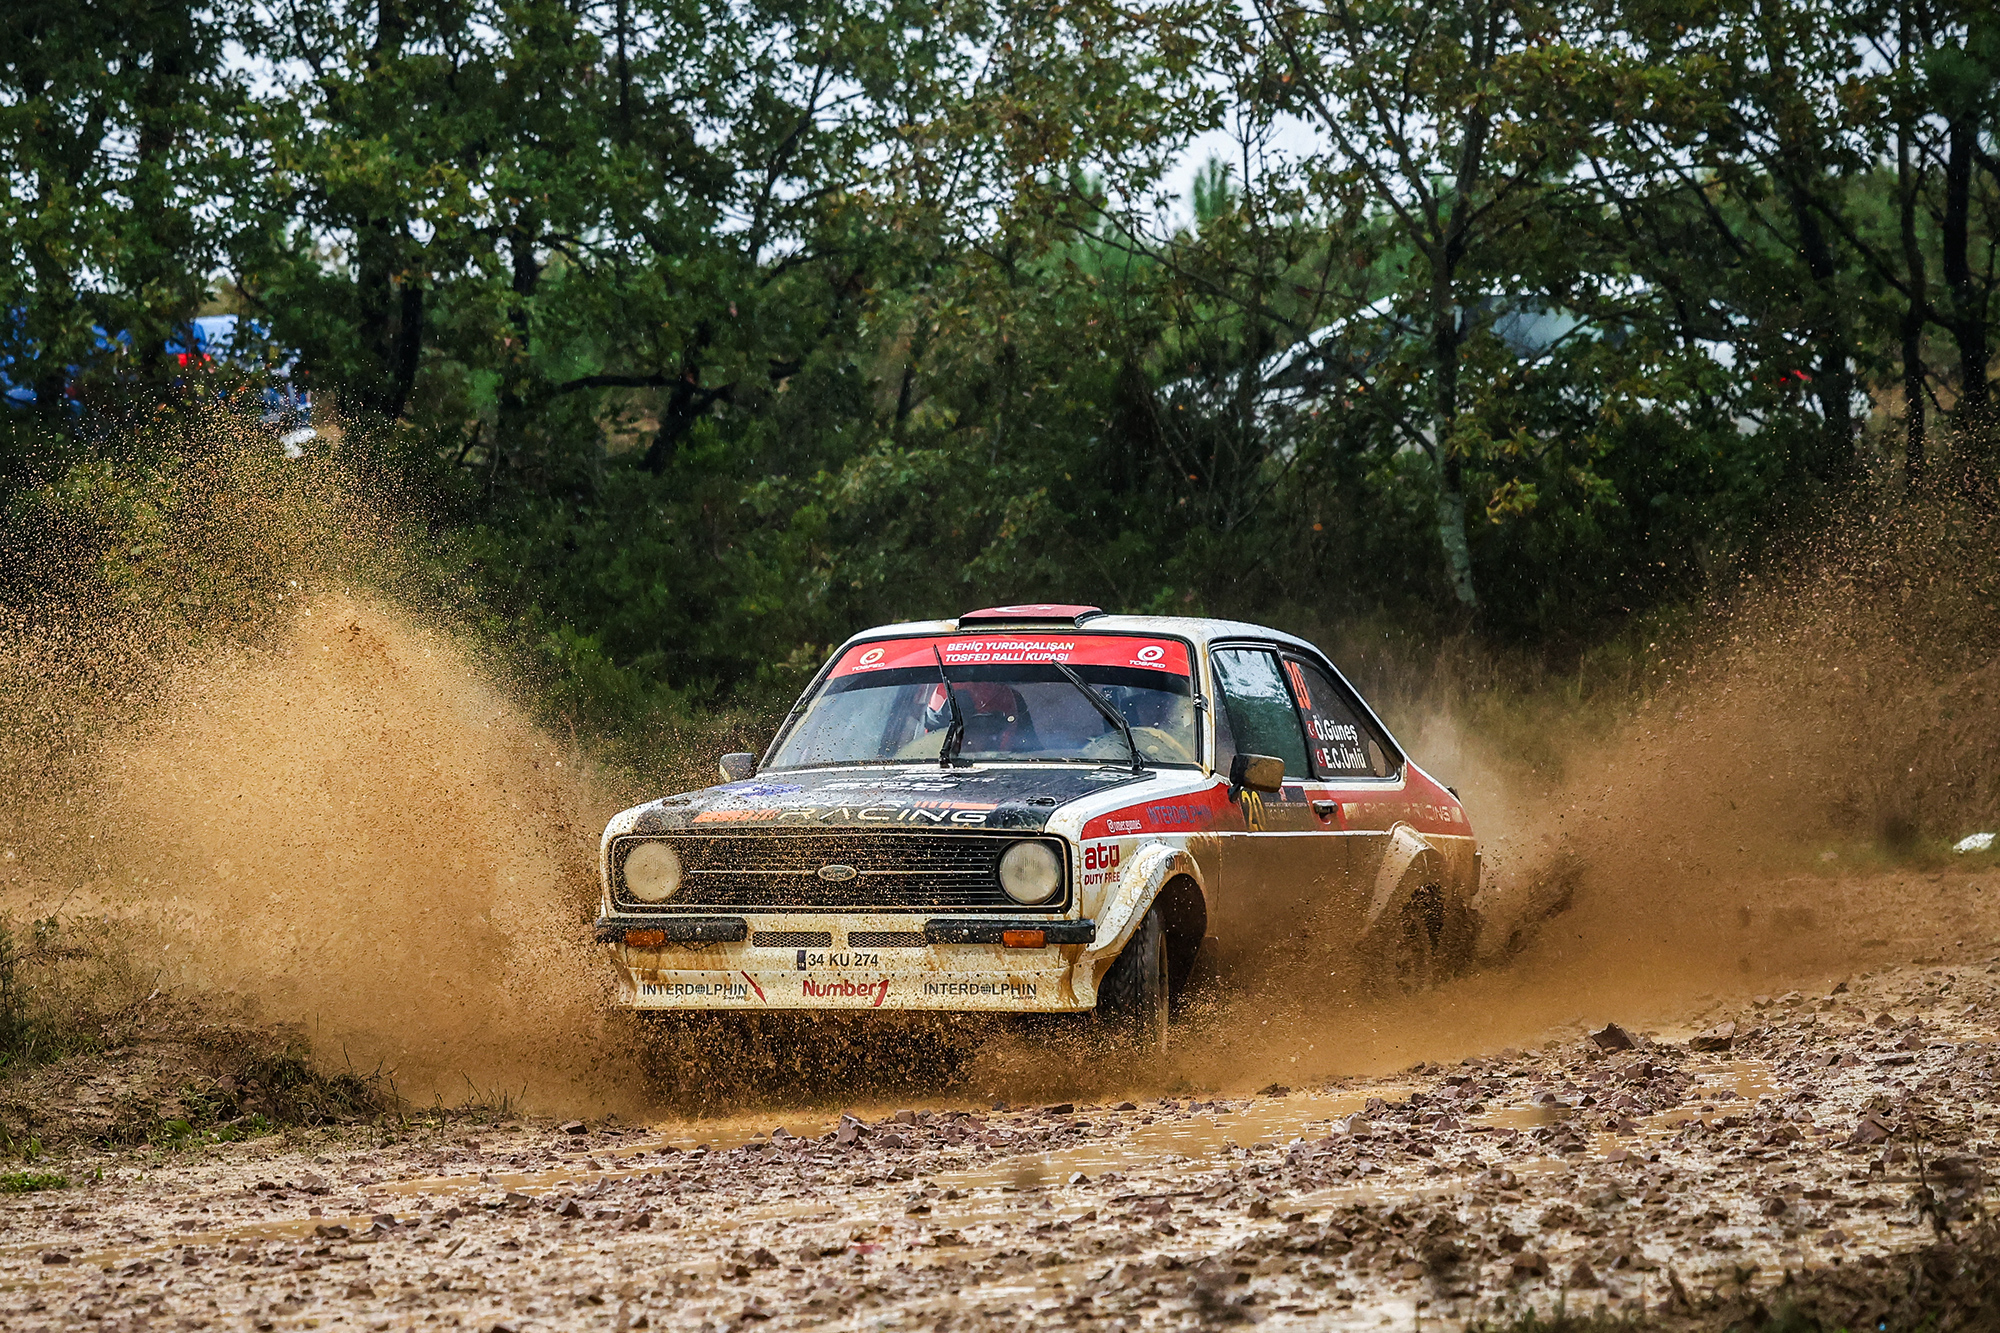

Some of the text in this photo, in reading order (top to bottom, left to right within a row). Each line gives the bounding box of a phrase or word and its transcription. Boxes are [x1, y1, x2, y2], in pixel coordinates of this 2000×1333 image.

[946, 641, 1075, 652] BEHİÇ YURDAÇALIŞAN
[945, 651, 1070, 662] TOSFED RALLİ KUPASI
[1313, 714, 1359, 746] Ö.Güneş
[1321, 743, 1367, 769] E.C.Ünlü
[777, 807, 991, 823] RACING
[1084, 871, 1121, 885] DUTY FREE
[808, 953, 879, 967] 34 KU 274
[642, 983, 748, 996] INTERDOLPHIN
[924, 983, 1037, 996] INTERDOLPHIN
